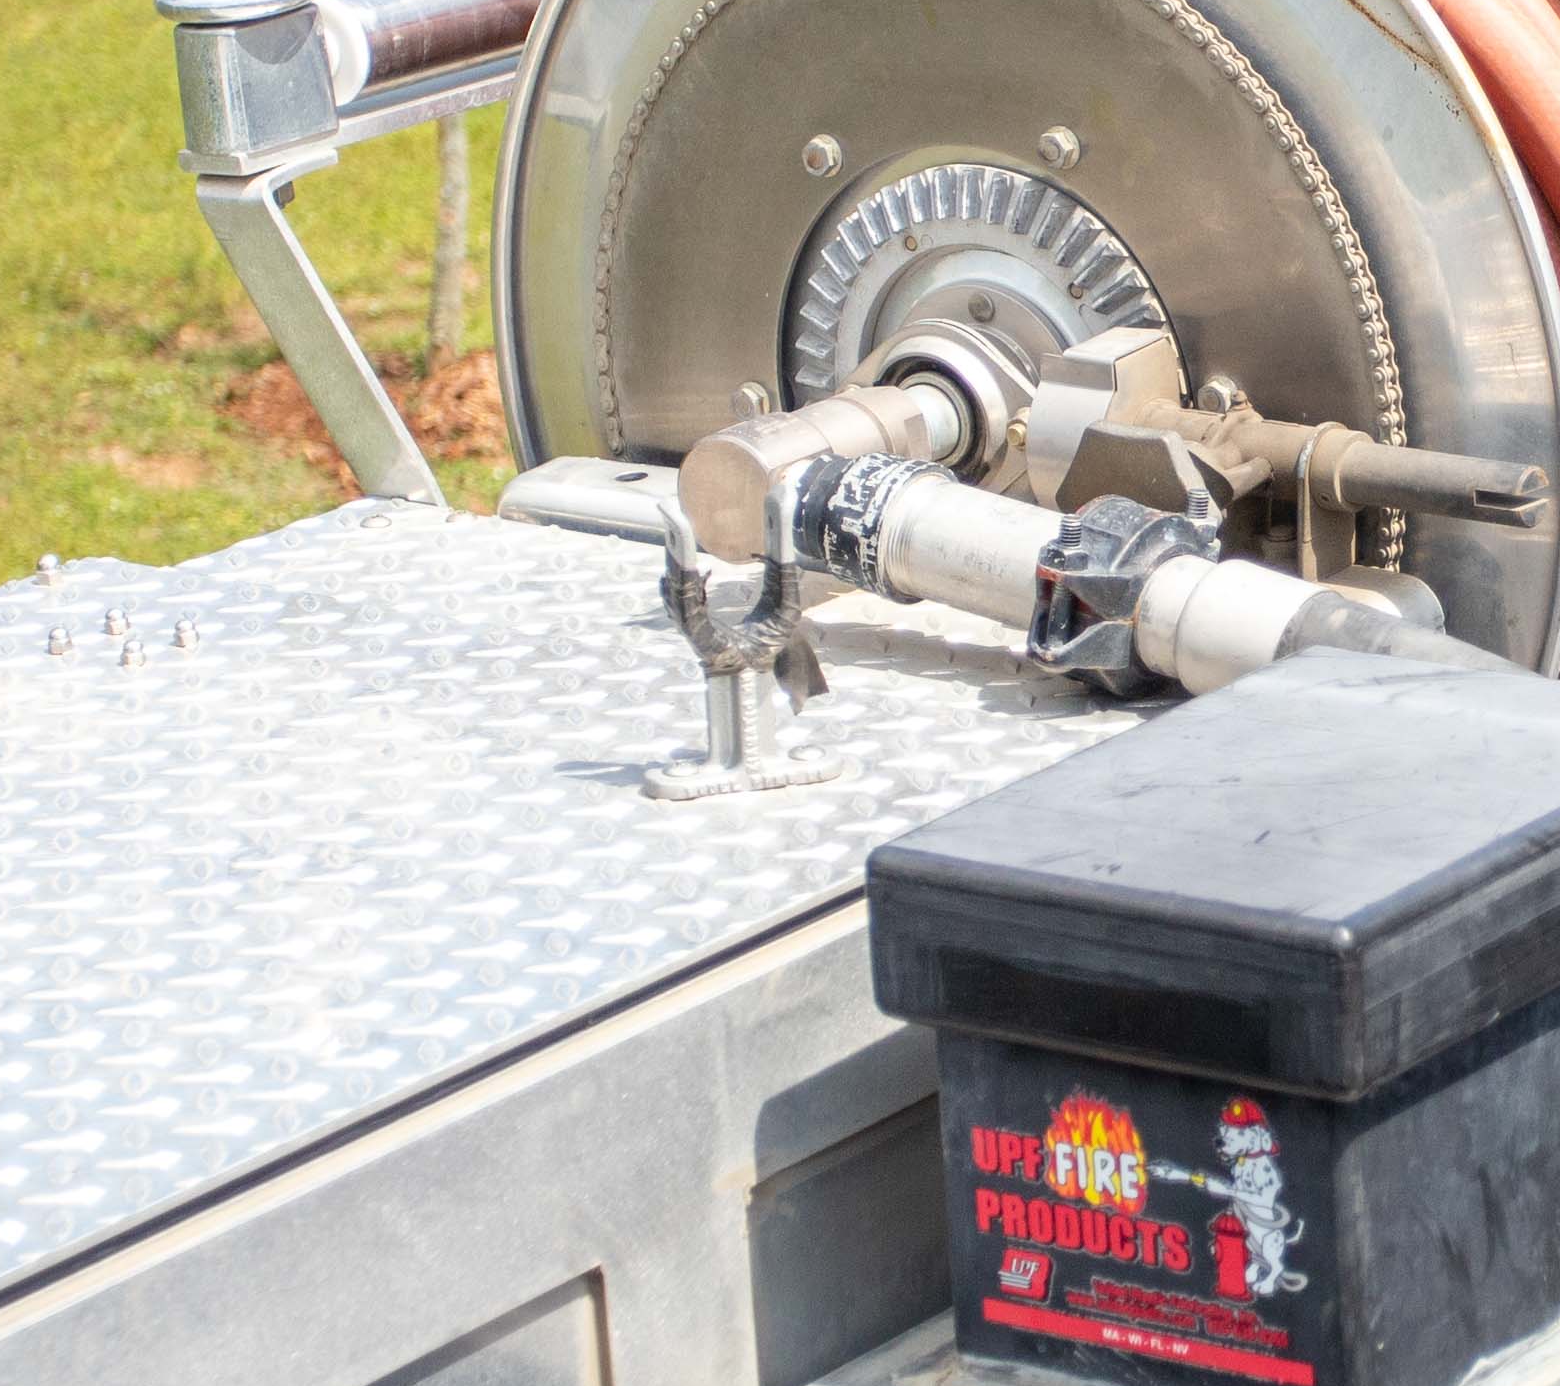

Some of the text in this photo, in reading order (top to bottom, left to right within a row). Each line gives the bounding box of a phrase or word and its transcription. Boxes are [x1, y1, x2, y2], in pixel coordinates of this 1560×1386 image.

[971, 1126, 1140, 1199] UPF FIRE
[975, 1188, 1192, 1272] PRODUCTS
